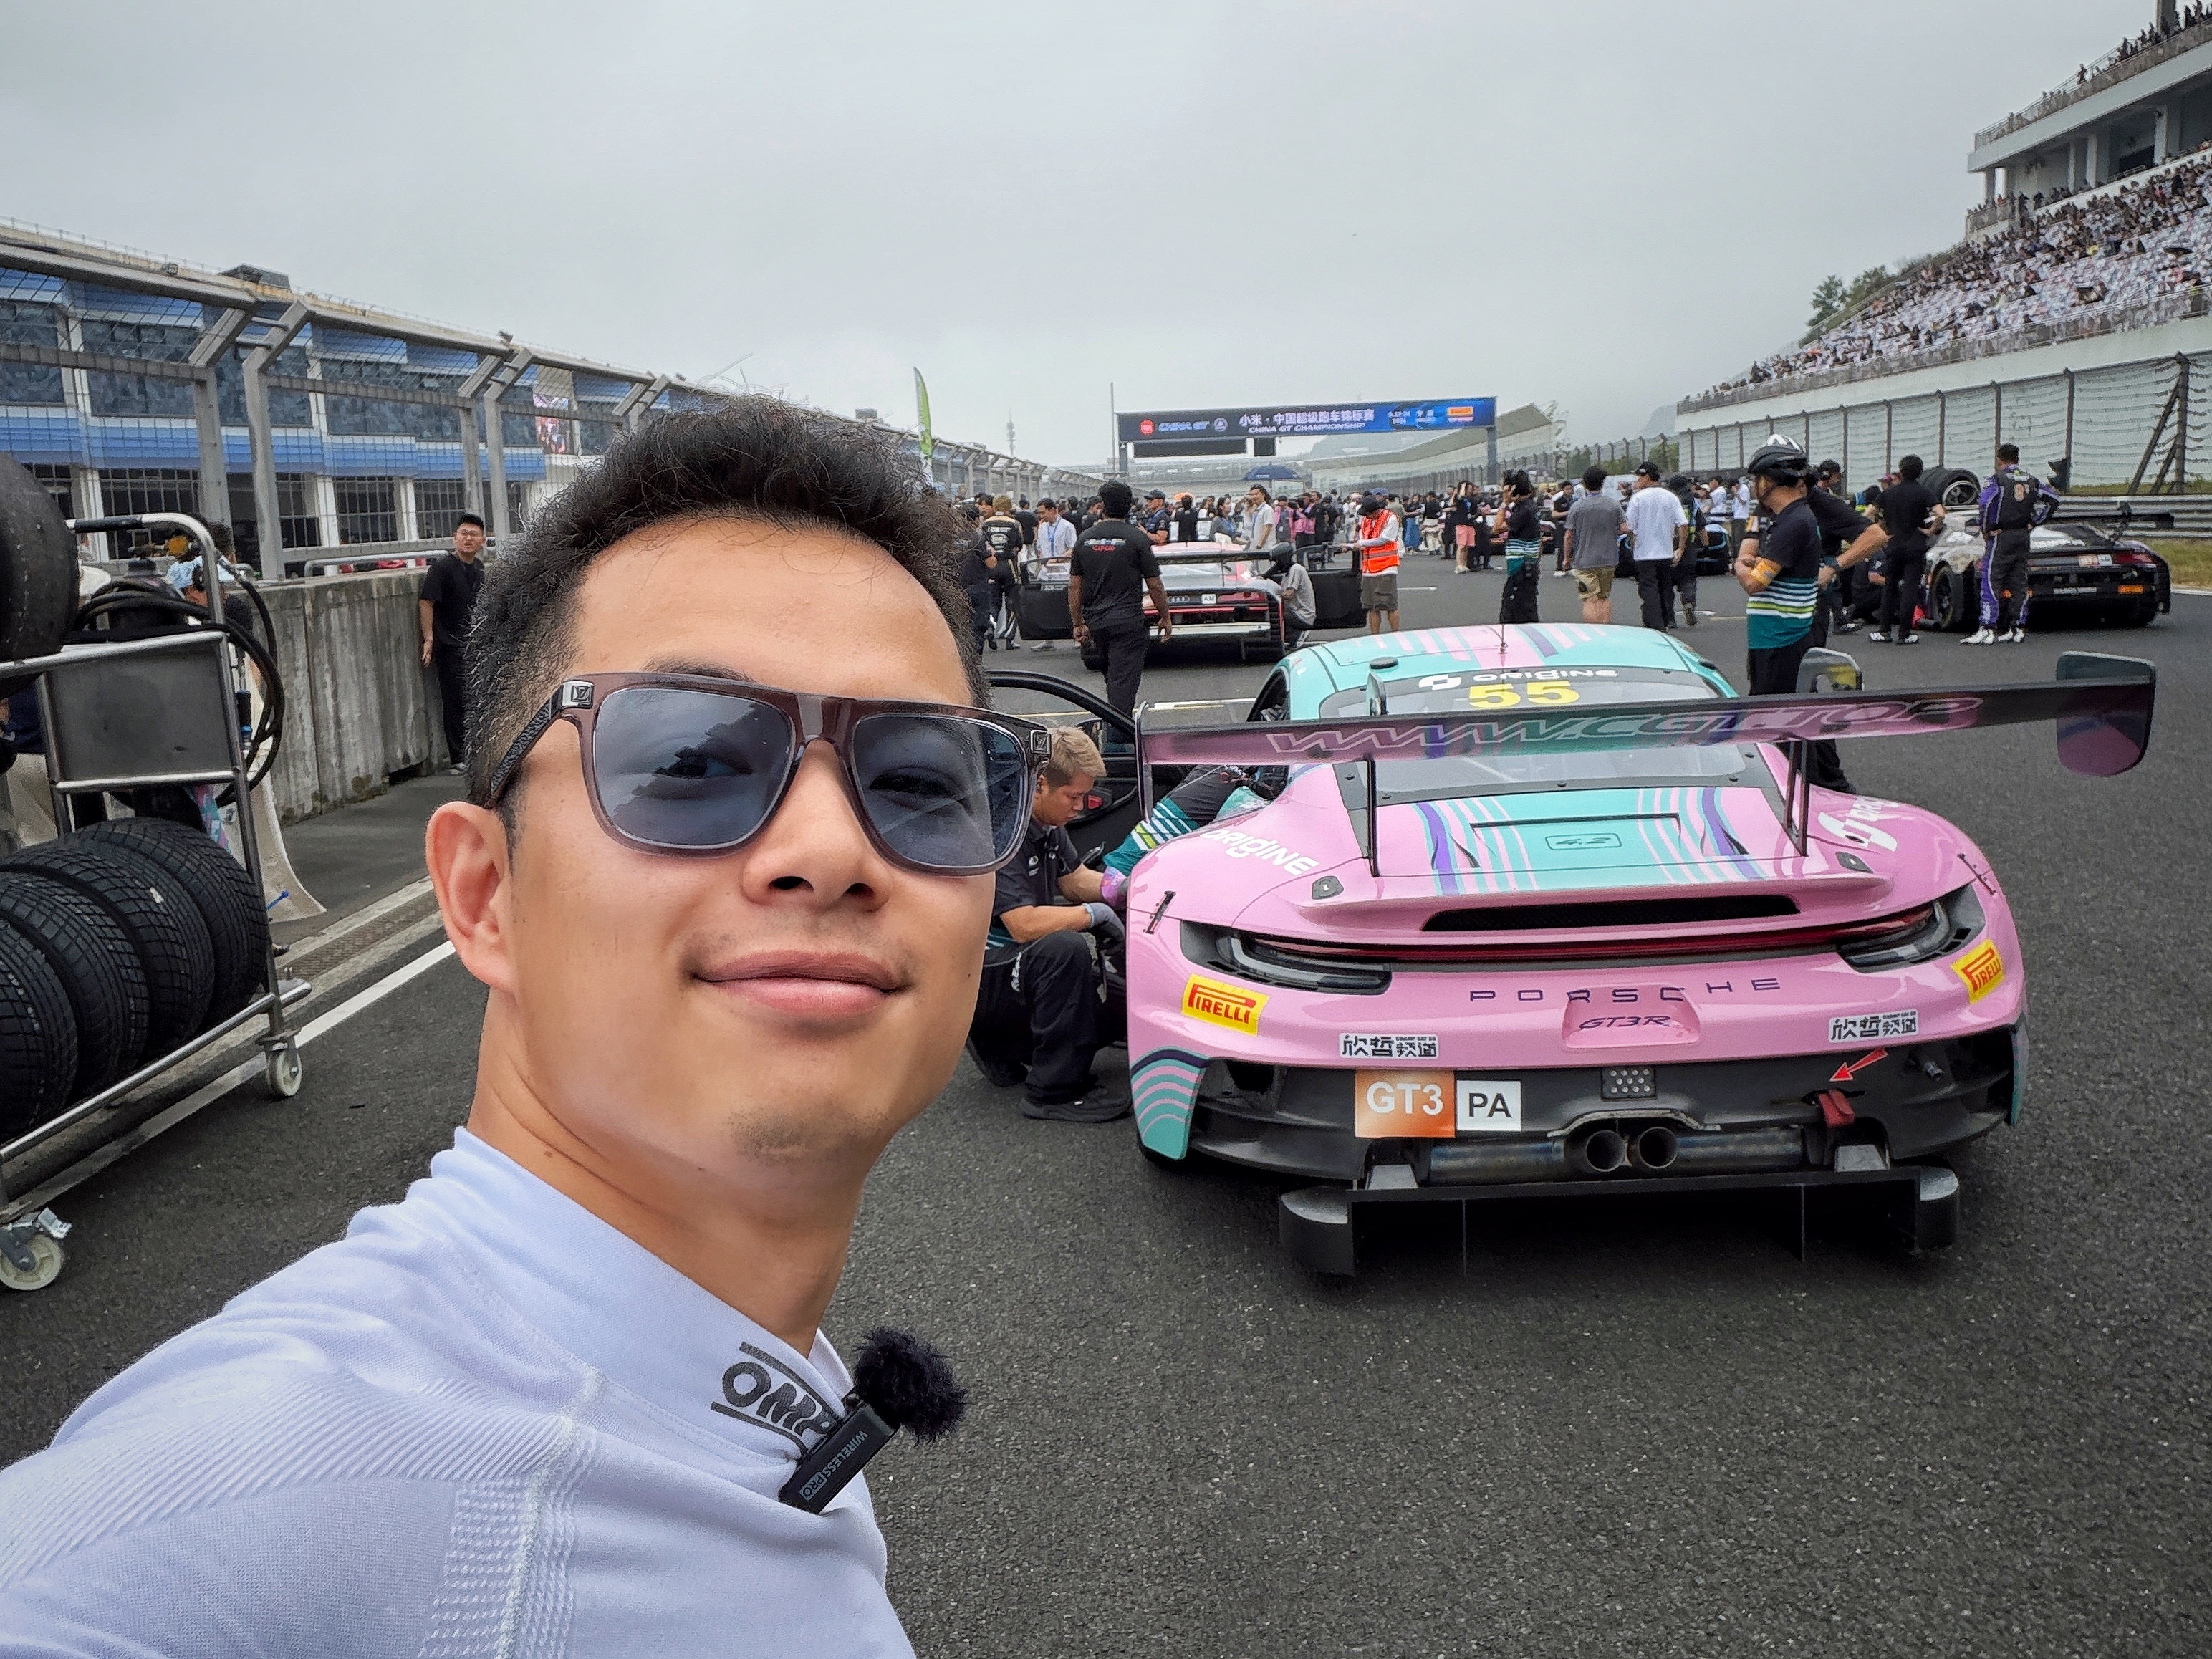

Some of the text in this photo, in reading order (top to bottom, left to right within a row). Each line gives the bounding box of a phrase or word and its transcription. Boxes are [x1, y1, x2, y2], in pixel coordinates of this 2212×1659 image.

[1469, 681, 1580, 709] 55
[1961, 947, 2001, 993] PIRELLI
[1188, 983, 1257, 1024] PIRELLI
[1470, 978, 1781, 1003] PORSCHE
[1367, 1082, 1444, 1115] GT3
[1468, 1092, 1513, 1118] PA
[802, 1430, 868, 1498] WIRELESS PRO
